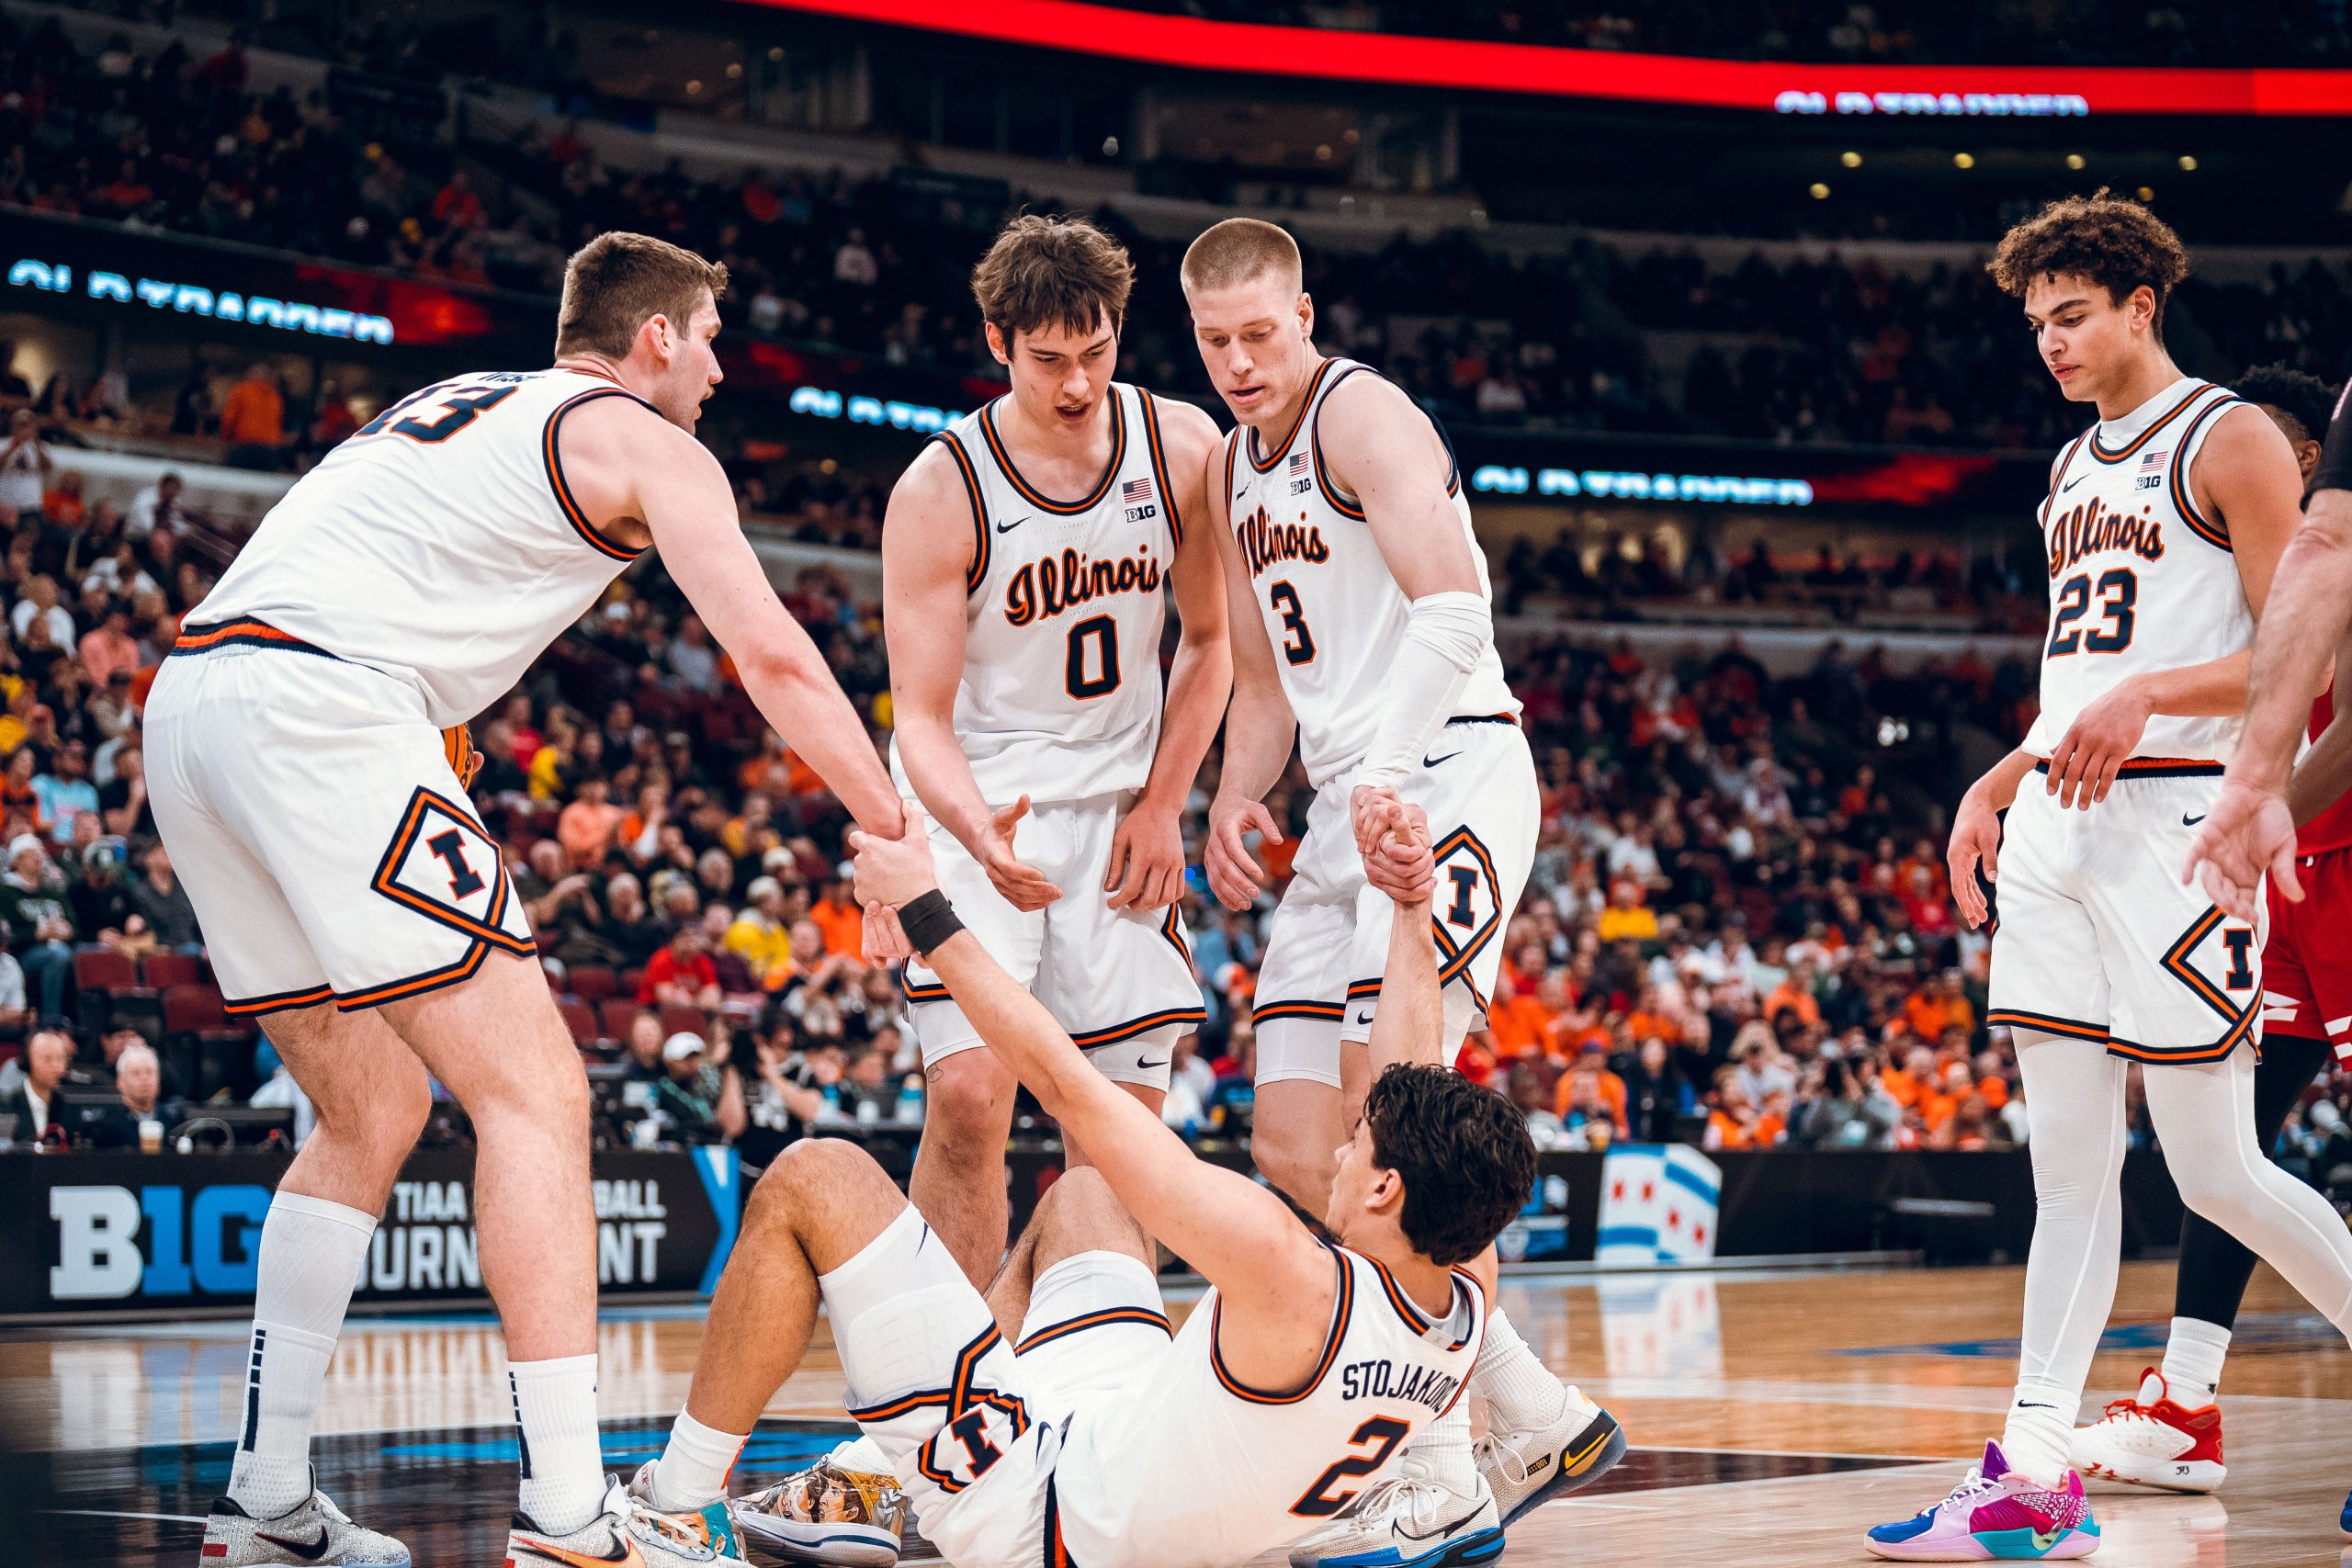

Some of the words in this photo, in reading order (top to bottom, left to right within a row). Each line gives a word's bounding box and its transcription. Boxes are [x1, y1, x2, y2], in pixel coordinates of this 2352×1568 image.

[352, 383, 518, 444] 13
[1238, 504, 1330, 579] Illinois
[2050, 496, 2165, 580] Illinois
[1004, 544, 1160, 626] Illinois
[2047, 567, 2138, 660] 23
[1066, 614, 1122, 700] 0
[1271, 580, 1317, 666] 3
[425, 827, 486, 901] I
[1447, 864, 1478, 931] I
[2223, 928, 2253, 990] I
[393, 1180, 468, 1222] TIAA
[950, 1408, 1003, 1479] I
[1288, 1415, 1411, 1517] 2
